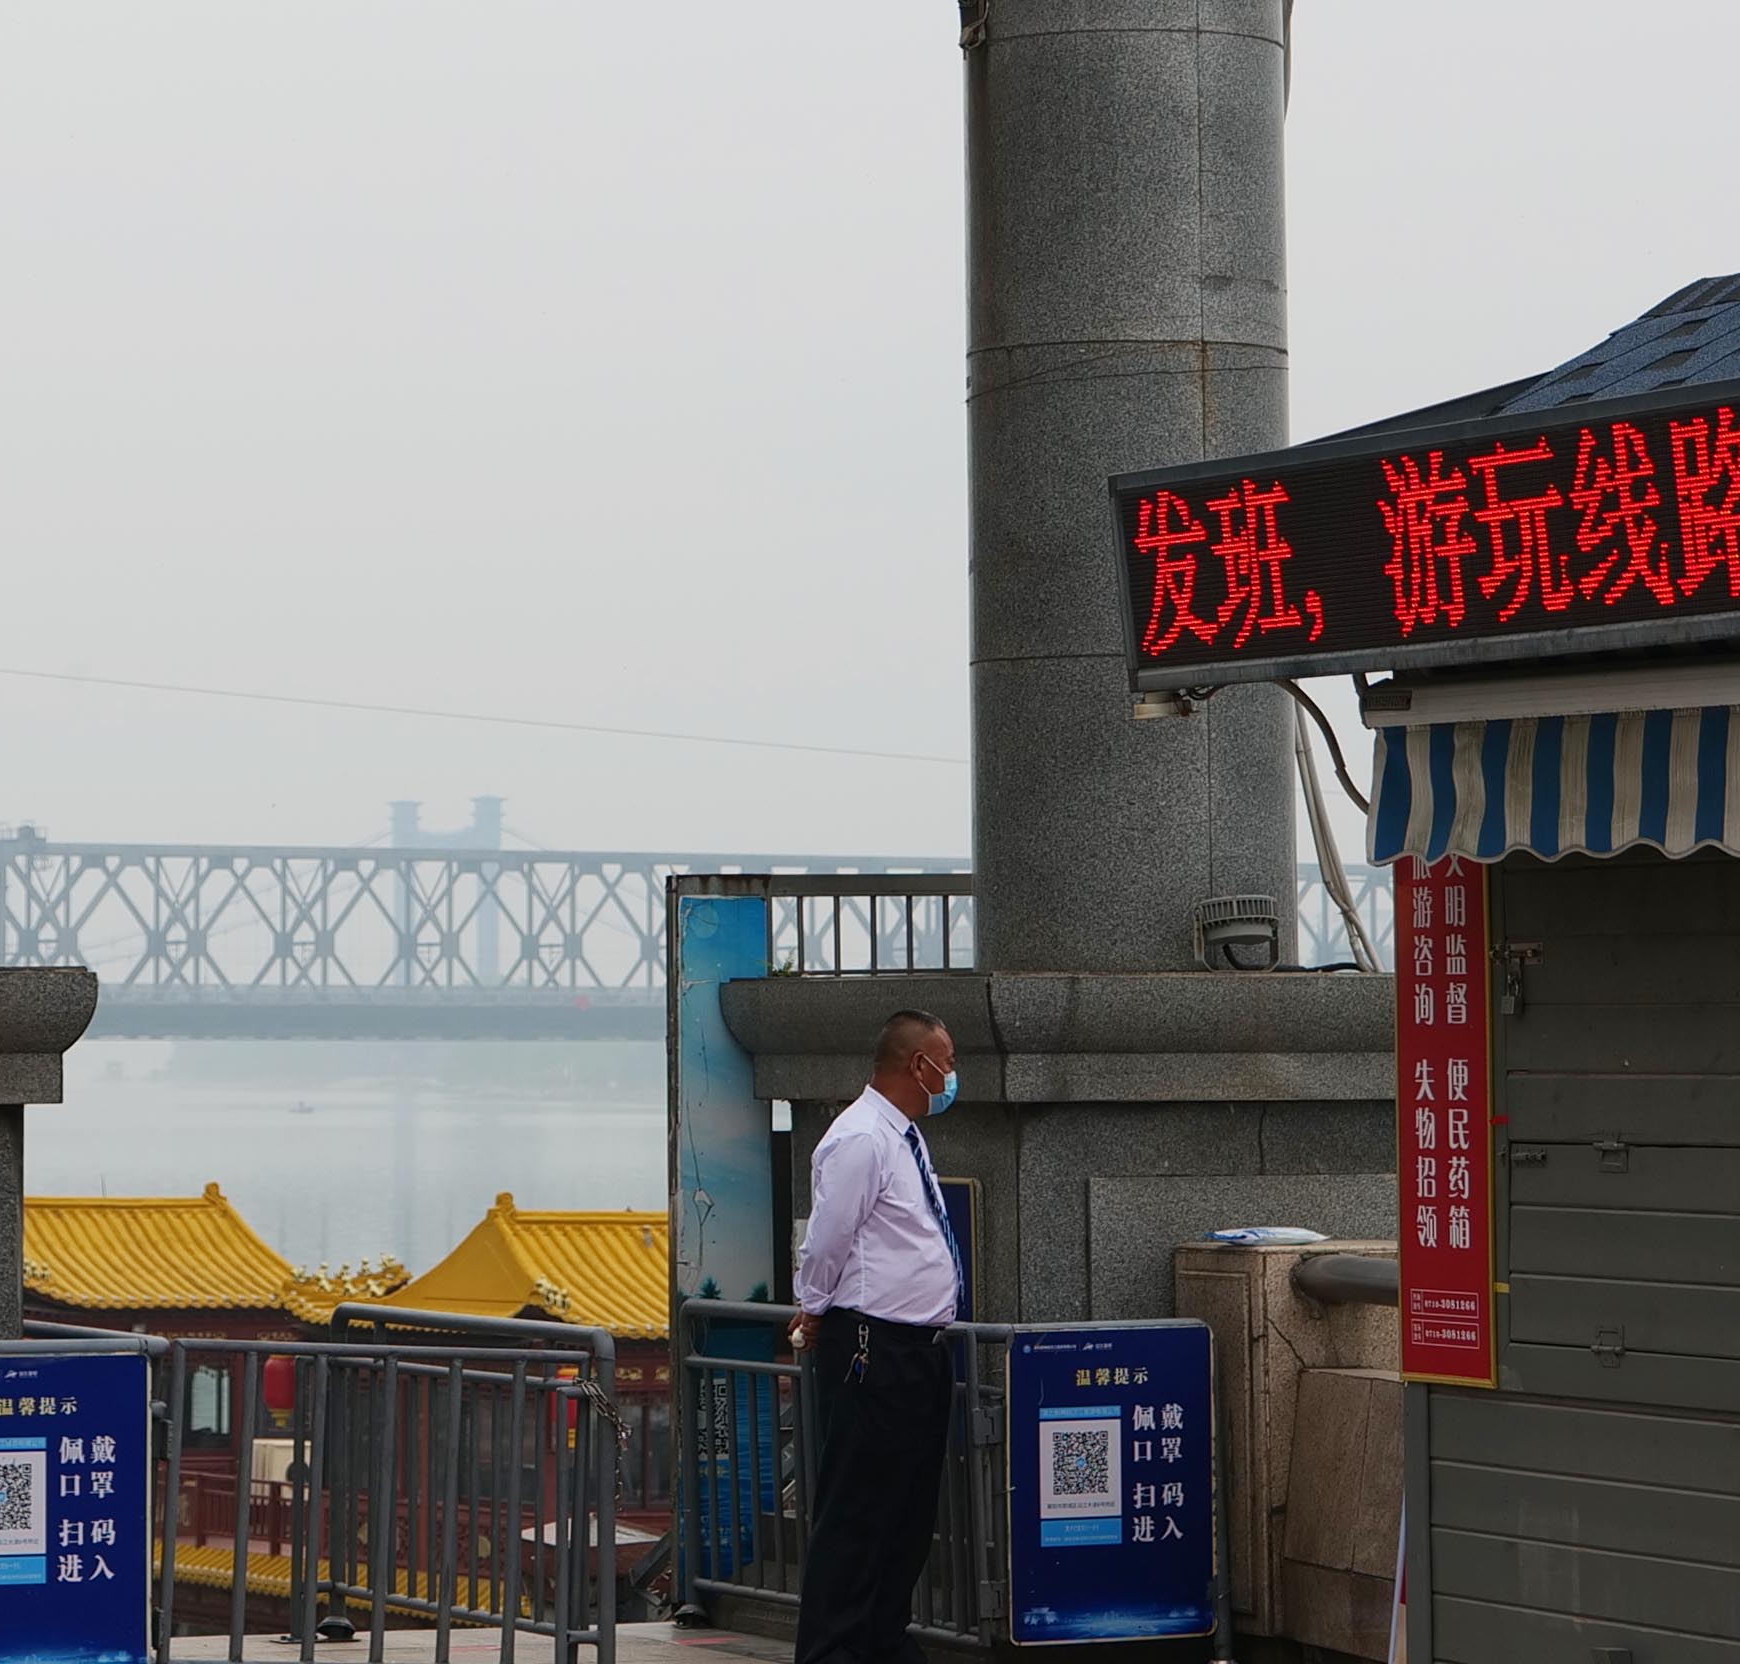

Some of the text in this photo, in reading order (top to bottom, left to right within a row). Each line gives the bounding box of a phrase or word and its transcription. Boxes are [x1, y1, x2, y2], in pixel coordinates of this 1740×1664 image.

[1415, 1058, 1437, 1248] 失物招领
[1447, 1058, 1470, 1249] 便民药箱
[1076, 1366, 1149, 1387] 温馨提示
[1132, 1403, 1184, 1431] 佩戴
[58, 1435, 117, 1464] 佩戴
[1133, 1437, 1182, 1463] 口罩
[60, 1471, 115, 1498] 口罩
[1132, 1482, 1184, 1509] 扫码
[58, 1519, 117, 1547] 扫码
[1132, 1516, 1184, 1543] 进入
[57, 1553, 115, 1583] 进入
